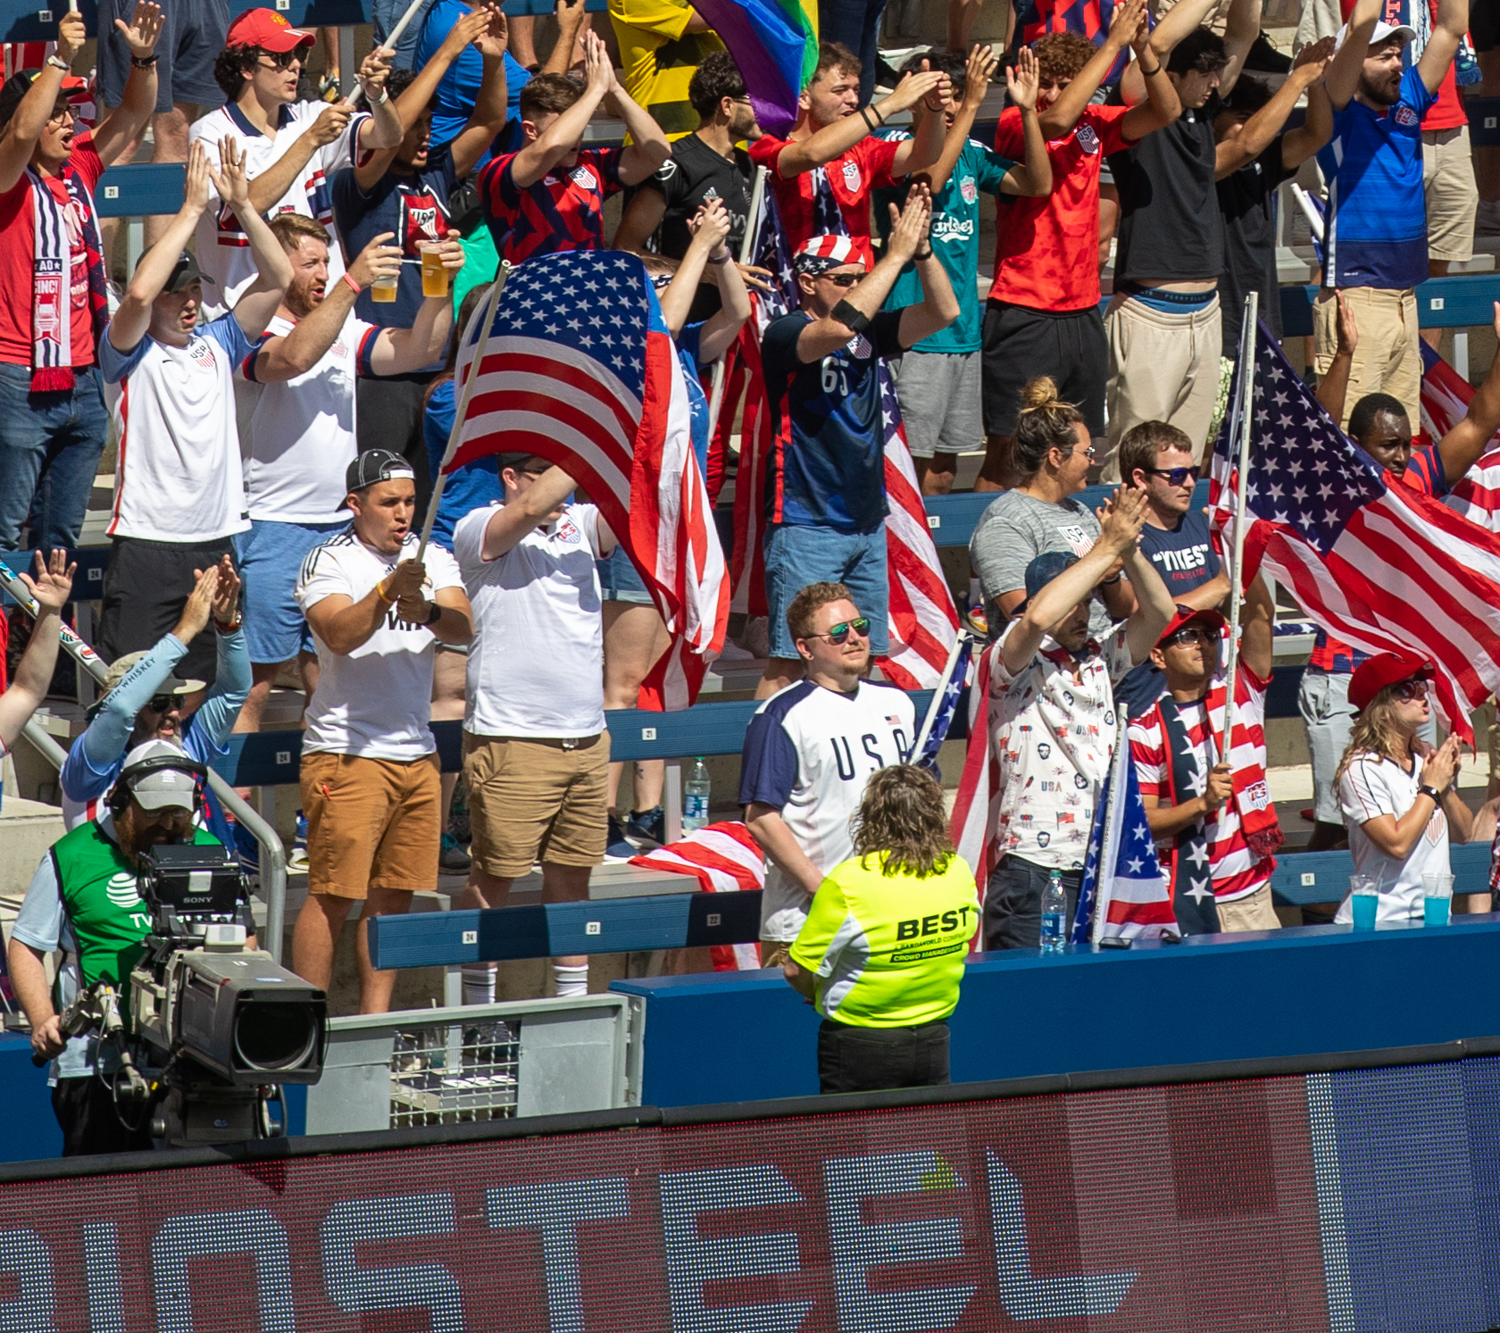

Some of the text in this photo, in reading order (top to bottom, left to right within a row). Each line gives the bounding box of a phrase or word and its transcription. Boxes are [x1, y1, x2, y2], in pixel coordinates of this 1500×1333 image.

[189, 344, 207, 360] USA
[1040, 780, 1062, 793] USA
[183, 896, 213, 904] SONY
[896, 905, 970, 941] BEST
